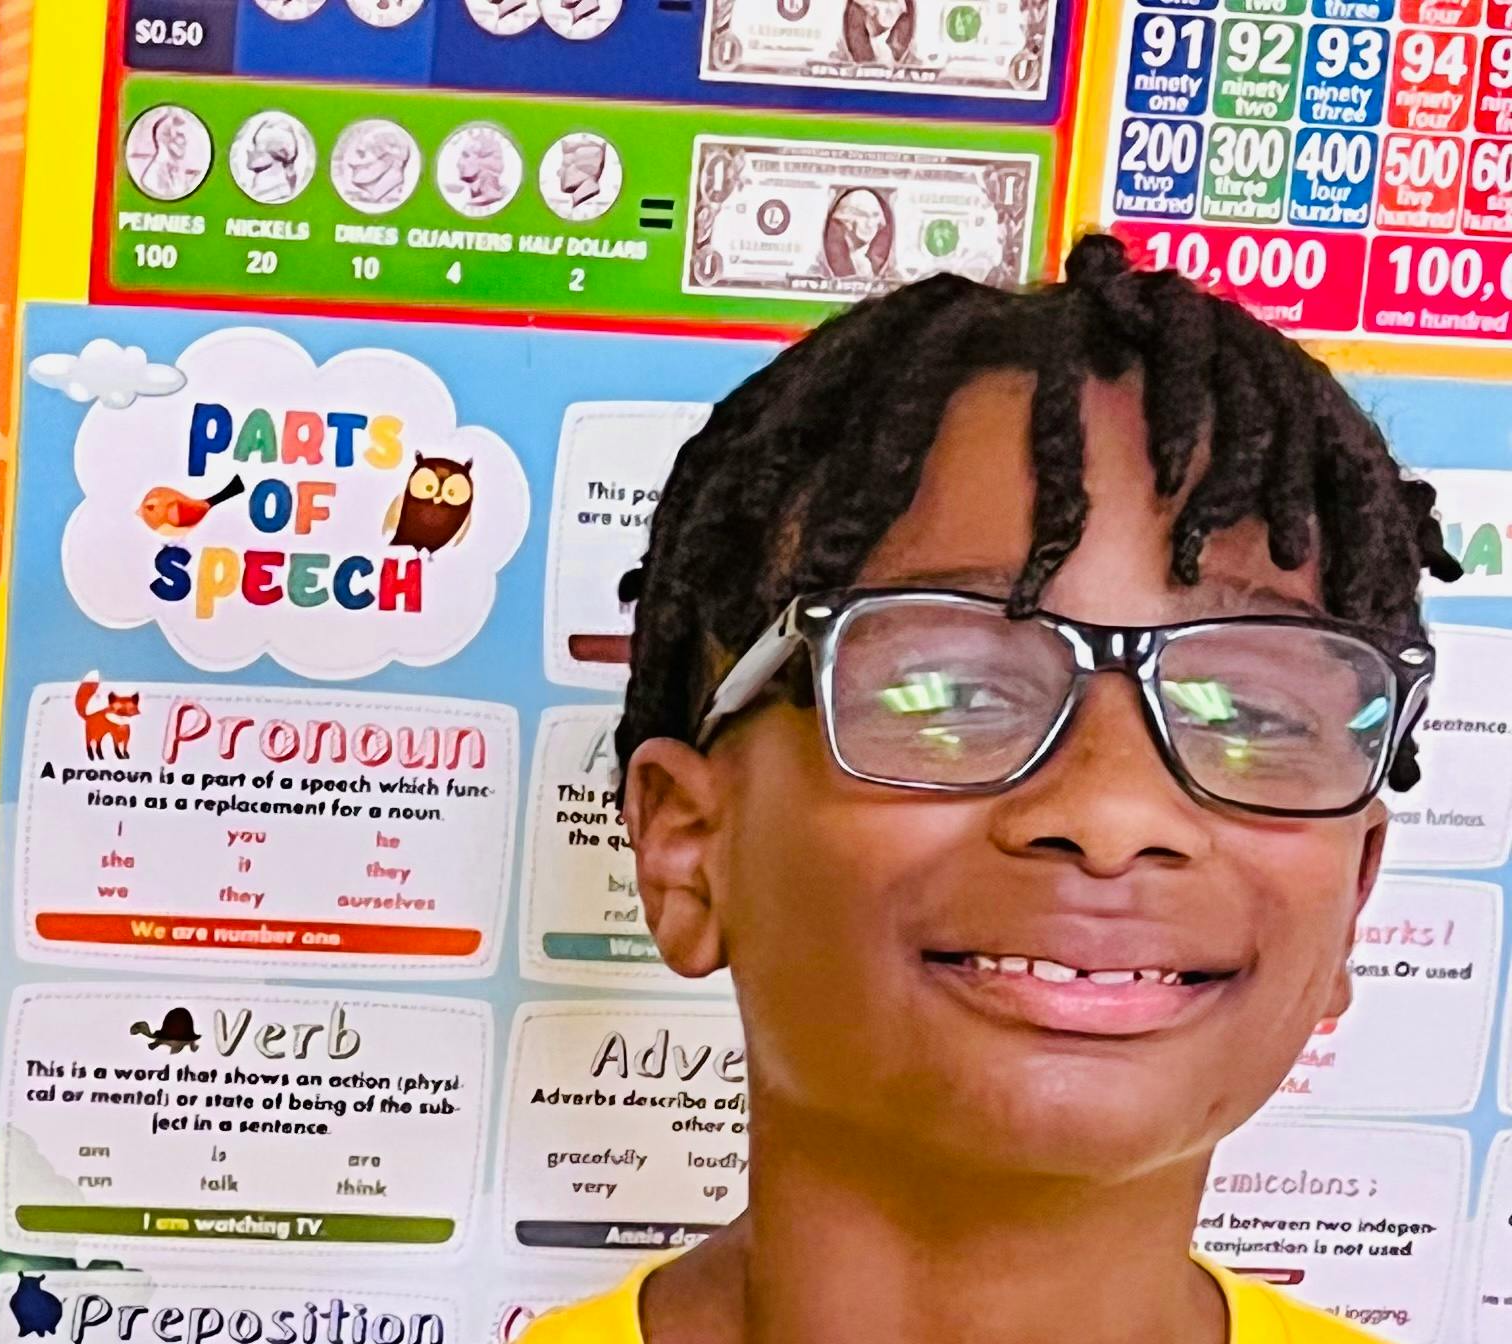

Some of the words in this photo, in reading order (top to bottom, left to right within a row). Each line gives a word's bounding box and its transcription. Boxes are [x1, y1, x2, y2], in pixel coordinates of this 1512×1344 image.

[135, 20, 203, 47] $0.50
[1142, 15, 1205, 70] 91
[1227, 21, 1295, 75] 92
[1316, 27, 1383, 80] 93
[1401, 33, 1468, 86] 94
[1135, 68, 1203, 98] ninety
[1222, 77, 1290, 103] ninety
[1306, 81, 1373, 108] ninety
[1149, 95, 1189, 111] one
[1235, 99, 1278, 119] two
[1312, 103, 1367, 123] three
[1121, 121, 1197, 174] 200
[1209, 126, 1284, 179] 300
[1295, 132, 1372, 184] 400
[1385, 137, 1459, 189] 500
[1134, 173, 1174, 192] two
[118, 212, 205, 236] PENNIES
[226, 218, 309, 241] NICKELS
[335, 224, 398, 246] DIMES
[408, 228, 513, 253] QUARTERS
[135, 244, 177, 269] 100
[247, 251, 277, 275] 20
[352, 257, 379, 280] 10
[1146, 231, 1327, 290] 10,000
[445, 261, 462, 284] 4
[570, 268, 584, 291] 2
[188, 402, 404, 477] PARTS
[588, 481, 625, 500] This
[249, 478, 337, 535] OF
[150, 545, 422, 620] SPEECH
[162, 701, 486, 770] Pronoun
[40, 762, 55, 779] A
[63, 767, 152, 785] pronoun
[160, 766, 174, 784] is
[182, 773, 195, 785] a
[202, 773, 245, 791] part
[252, 770, 274, 788] of
[280, 777, 292, 790] a
[301, 775, 371, 795] speech
[379, 776, 439, 796] which
[88, 790, 137, 808] tions
[144, 797, 167, 810] as
[175, 798, 187, 811] a
[195, 795, 325, 816] replacement
[331, 799, 362, 817] for
[369, 806, 381, 819] a
[227, 830, 266, 847] you
[376, 831, 400, 849] he
[569, 829, 599, 846] the
[98, 886, 128, 898] we
[337, 893, 435, 910] ourselves
[130, 920, 166, 939] We
[172, 926, 208, 941] are
[214, 924, 296, 944] number
[301, 931, 341, 946] one
[214, 1002, 361, 1060] Verb
[26, 1060, 64, 1078] This
[71, 1061, 86, 1079] is
[94, 1067, 107, 1079] a
[115, 1064, 169, 1082] word
[177, 1065, 217, 1083] that
[225, 1066, 289, 1086] shows
[296, 1074, 322, 1087] an
[329, 1072, 389, 1090] action
[27, 1084, 56, 1102] cal
[62, 1090, 84, 1102] or
[177, 1094, 198, 1107] or
[206, 1094, 254, 1109] state
[262, 1092, 282, 1110] of
[289, 1093, 346, 1116] being
[353, 1095, 375, 1113] of
[380, 1096, 412, 1114] the
[531, 1088, 616, 1105] Adverbs
[623, 1090, 706, 1108] describe
[548, 1149, 647, 1171] gracefully
[572, 1182, 617, 1199] very
[703, 1186, 728, 1201] up
